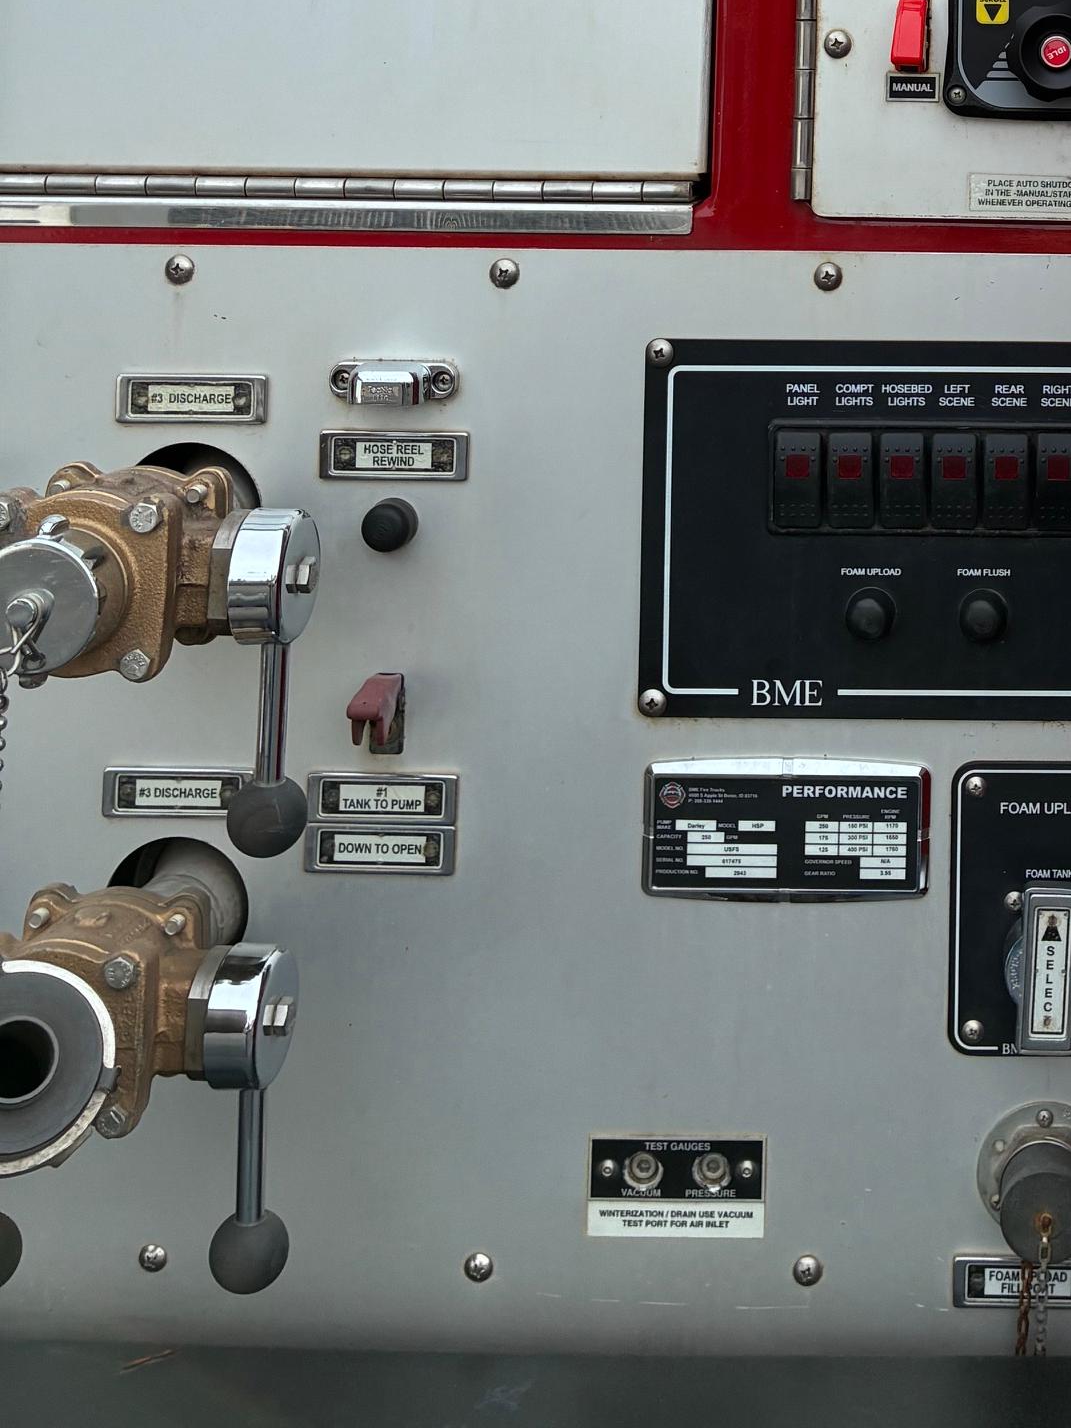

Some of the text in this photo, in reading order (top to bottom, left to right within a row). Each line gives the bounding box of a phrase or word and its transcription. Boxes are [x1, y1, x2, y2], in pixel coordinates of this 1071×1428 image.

[1046, 46, 1066, 60] IDLE
[892, 83, 933, 92] MANUAL
[787, 384, 820, 393] PANEL
[836, 384, 874, 393] COMPT
[882, 384, 932, 394] HOSEBED
[944, 385, 970, 394] LEFT
[995, 385, 1024, 394] REAR
[151, 393, 232, 404] #3 DISCHARGE
[788, 397, 818, 406] LIGHT
[836, 397, 873, 406] LIGHTS
[888, 397, 926, 406] LIGHTS
[939, 397, 975, 406] SCENE
[992, 397, 1027, 407] SCENE
[363, 444, 424, 455] HOSE REEL
[372, 456, 415, 467] REWIND
[841, 567, 901, 576] FOAM UPLOAD
[957, 568, 1010, 577] FOAM FLUSH
[751, 680, 823, 706] BME
[139, 788, 217, 799] #3 DISCHARGE
[376, 788, 388, 797] #1
[782, 785, 907, 798] PERFORMANCE
[342, 799, 421, 810] TANK TO PUMP
[1000, 802, 1040, 813] FOAM
[338, 844, 422, 855] DOWN TO OPEN
[1026, 870, 1050, 878] FOAM
[645, 1142, 711, 1151] TEST GAUGES
[621, 1189, 661, 1197] VACUUM
[622, 1219, 643, 1227] TEST
[989, 1270, 1019, 1281] FOAM
